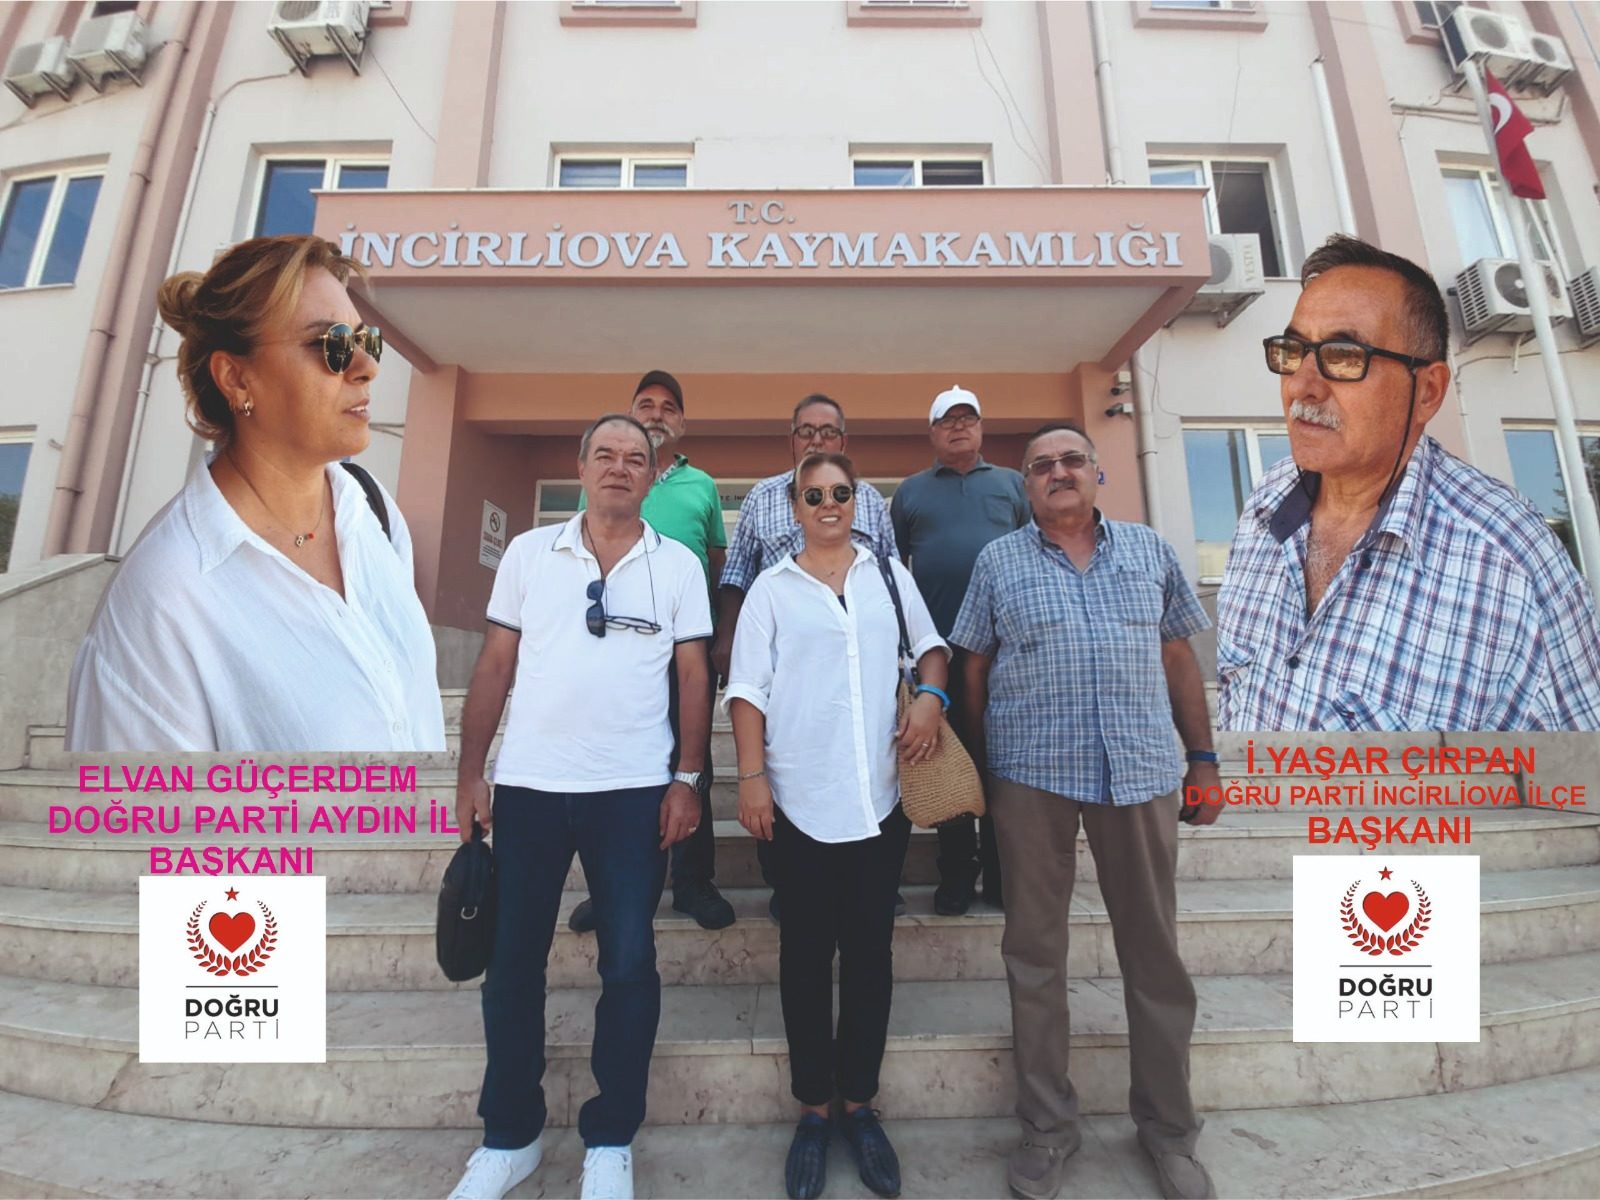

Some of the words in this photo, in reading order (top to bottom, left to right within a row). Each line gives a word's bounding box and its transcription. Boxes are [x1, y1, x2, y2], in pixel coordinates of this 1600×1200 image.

[728, 200, 796, 224] T.C.
[339, 223, 689, 268] İNCİRLİOVA
[706, 222, 1184, 268] KAYMAKAMLIĞI
